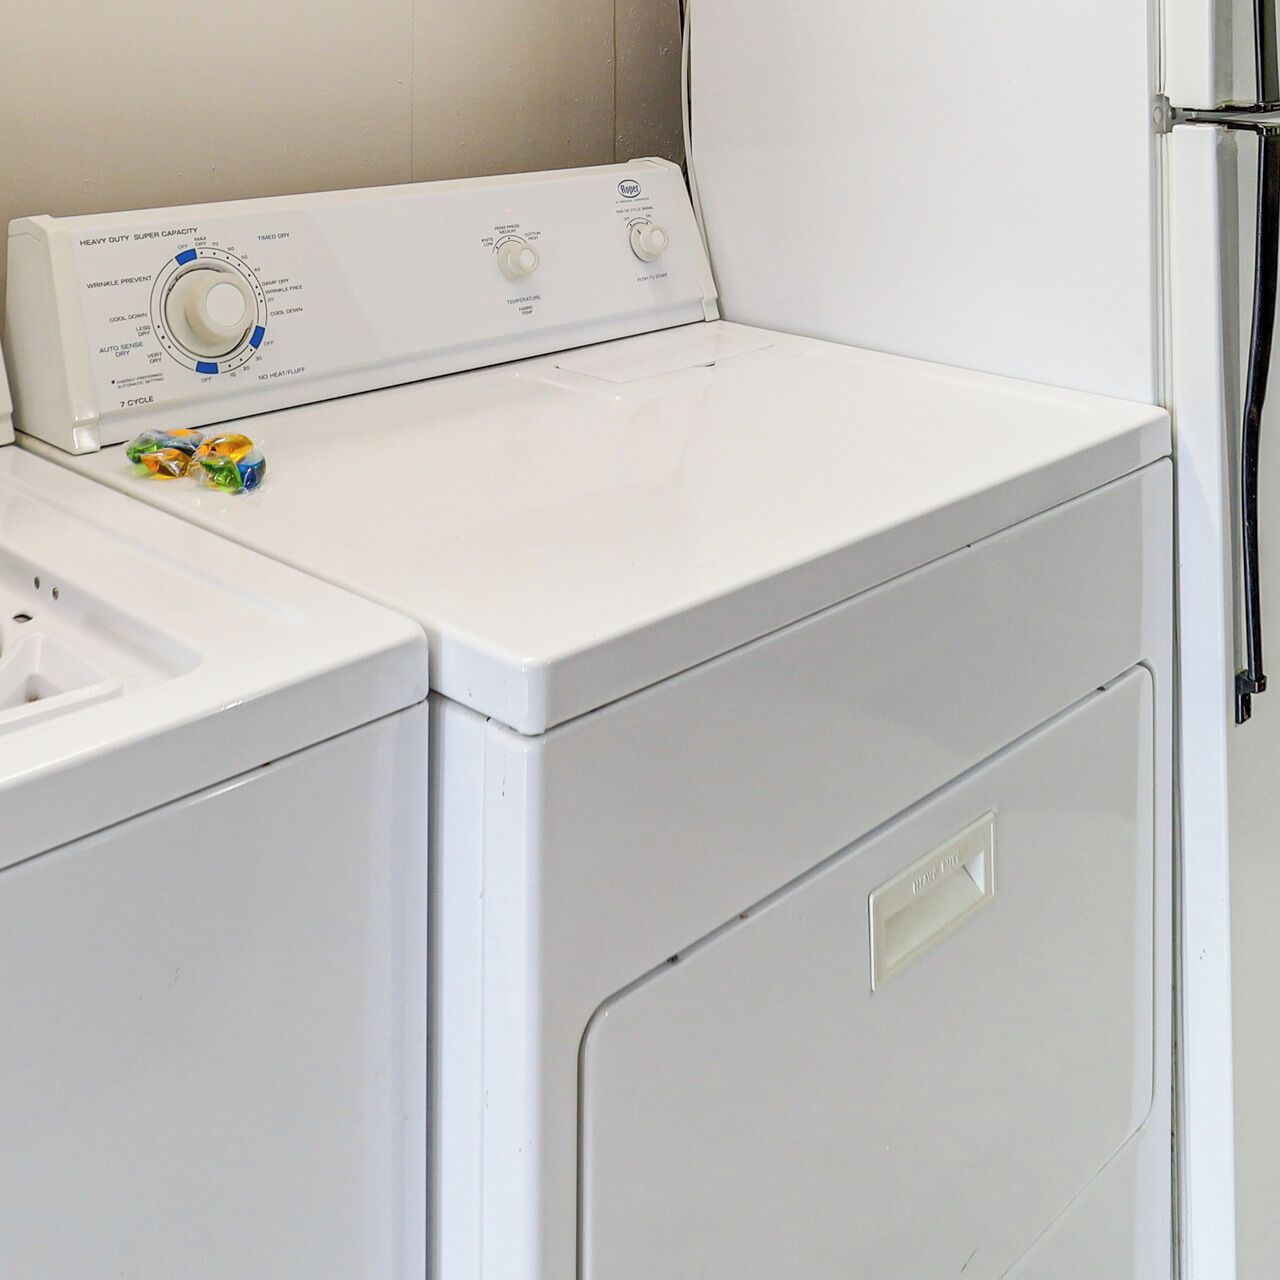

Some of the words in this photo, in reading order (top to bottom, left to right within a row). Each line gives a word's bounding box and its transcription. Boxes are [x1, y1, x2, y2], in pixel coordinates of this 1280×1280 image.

[80, 238, 107, 247] HEAVY
[108, 235, 130, 243] DUTY
[133, 231, 160, 241] SUPER
[161, 227, 198, 237] CAPACITY
[86, 279, 119, 289] WRINKLE
[120, 275, 152, 284] PREVENT
[265, 287, 289, 295] WRINKLE
[507, 295, 541, 305] TEMPERATURE
[99, 345, 119, 354] AUTO
[120, 341, 144, 350] SENSE
[115, 350, 130, 358] DRY
[127, 395, 154, 407] CYCLE
